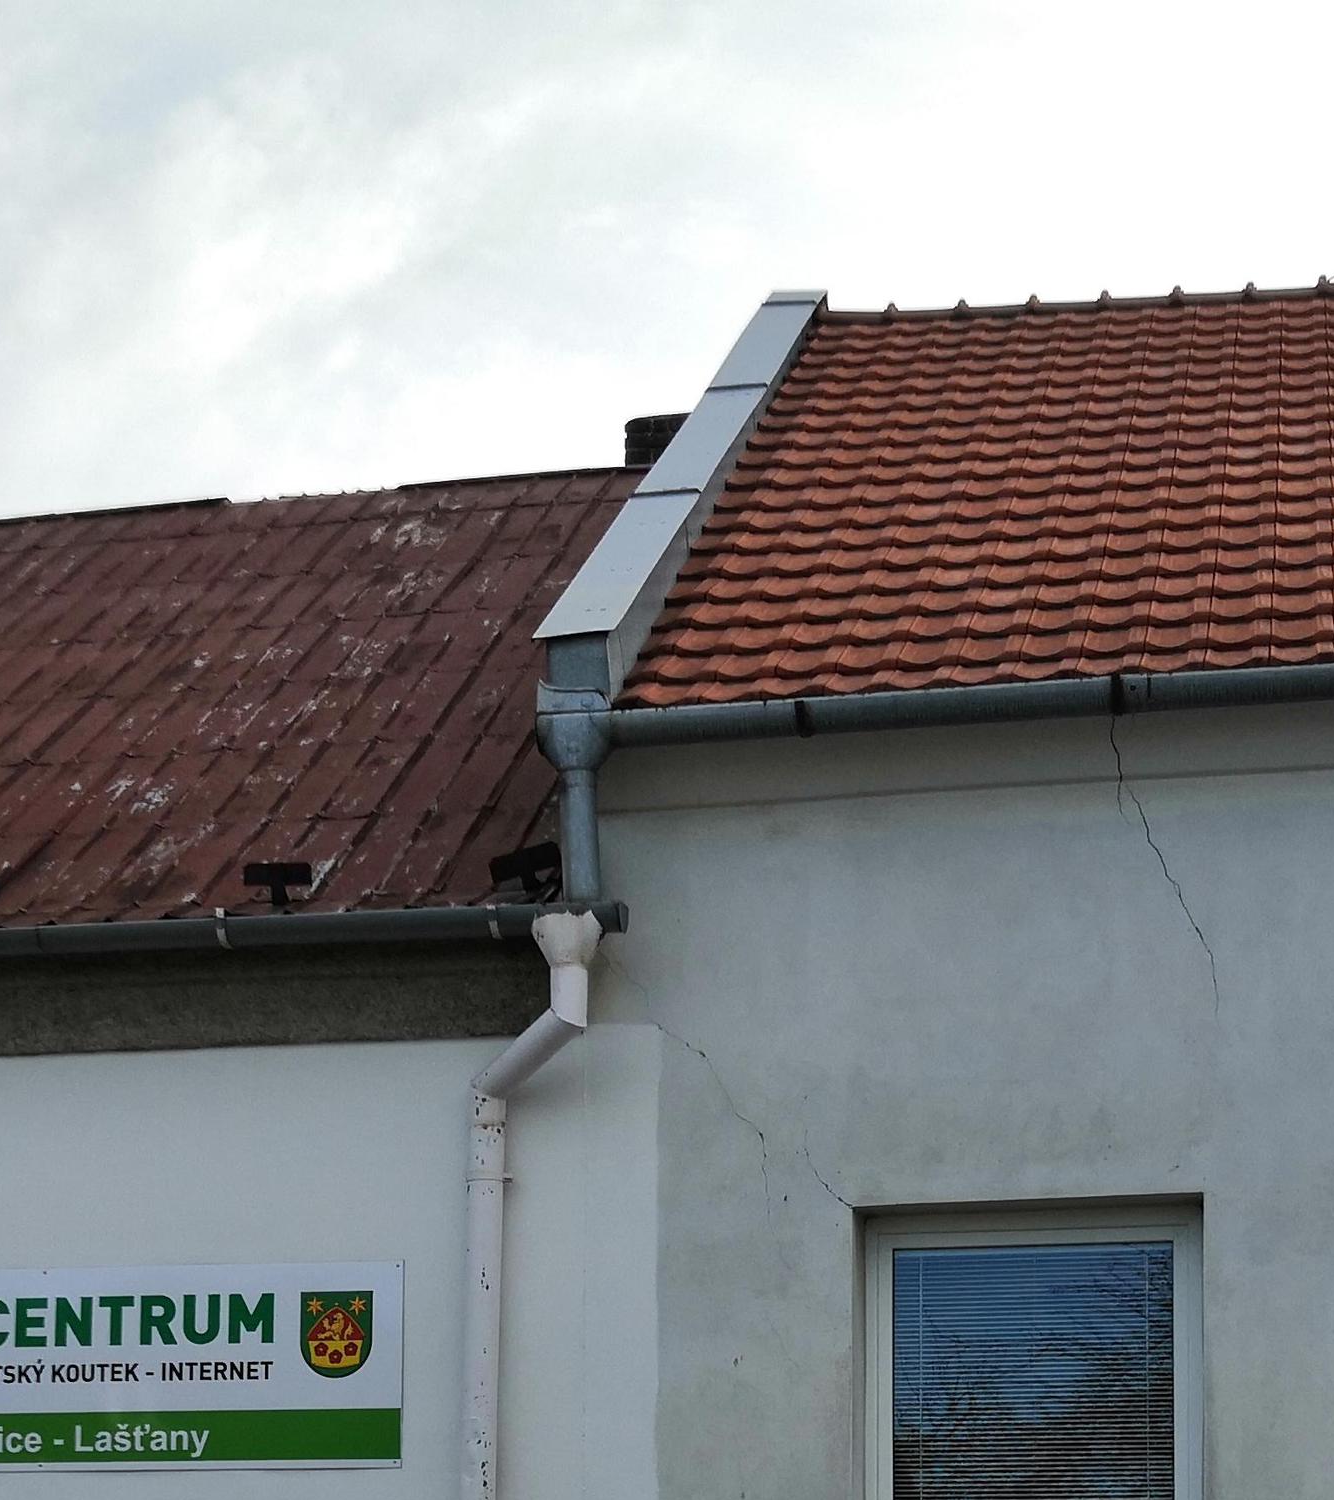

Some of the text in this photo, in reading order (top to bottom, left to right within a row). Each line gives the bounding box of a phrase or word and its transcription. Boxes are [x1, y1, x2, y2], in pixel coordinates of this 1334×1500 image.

[51, 1363, 140, 1384] KOUTEK
[161, 1360, 274, 1382] INTERNET
[74, 1423, 210, 1459] Lašťany
